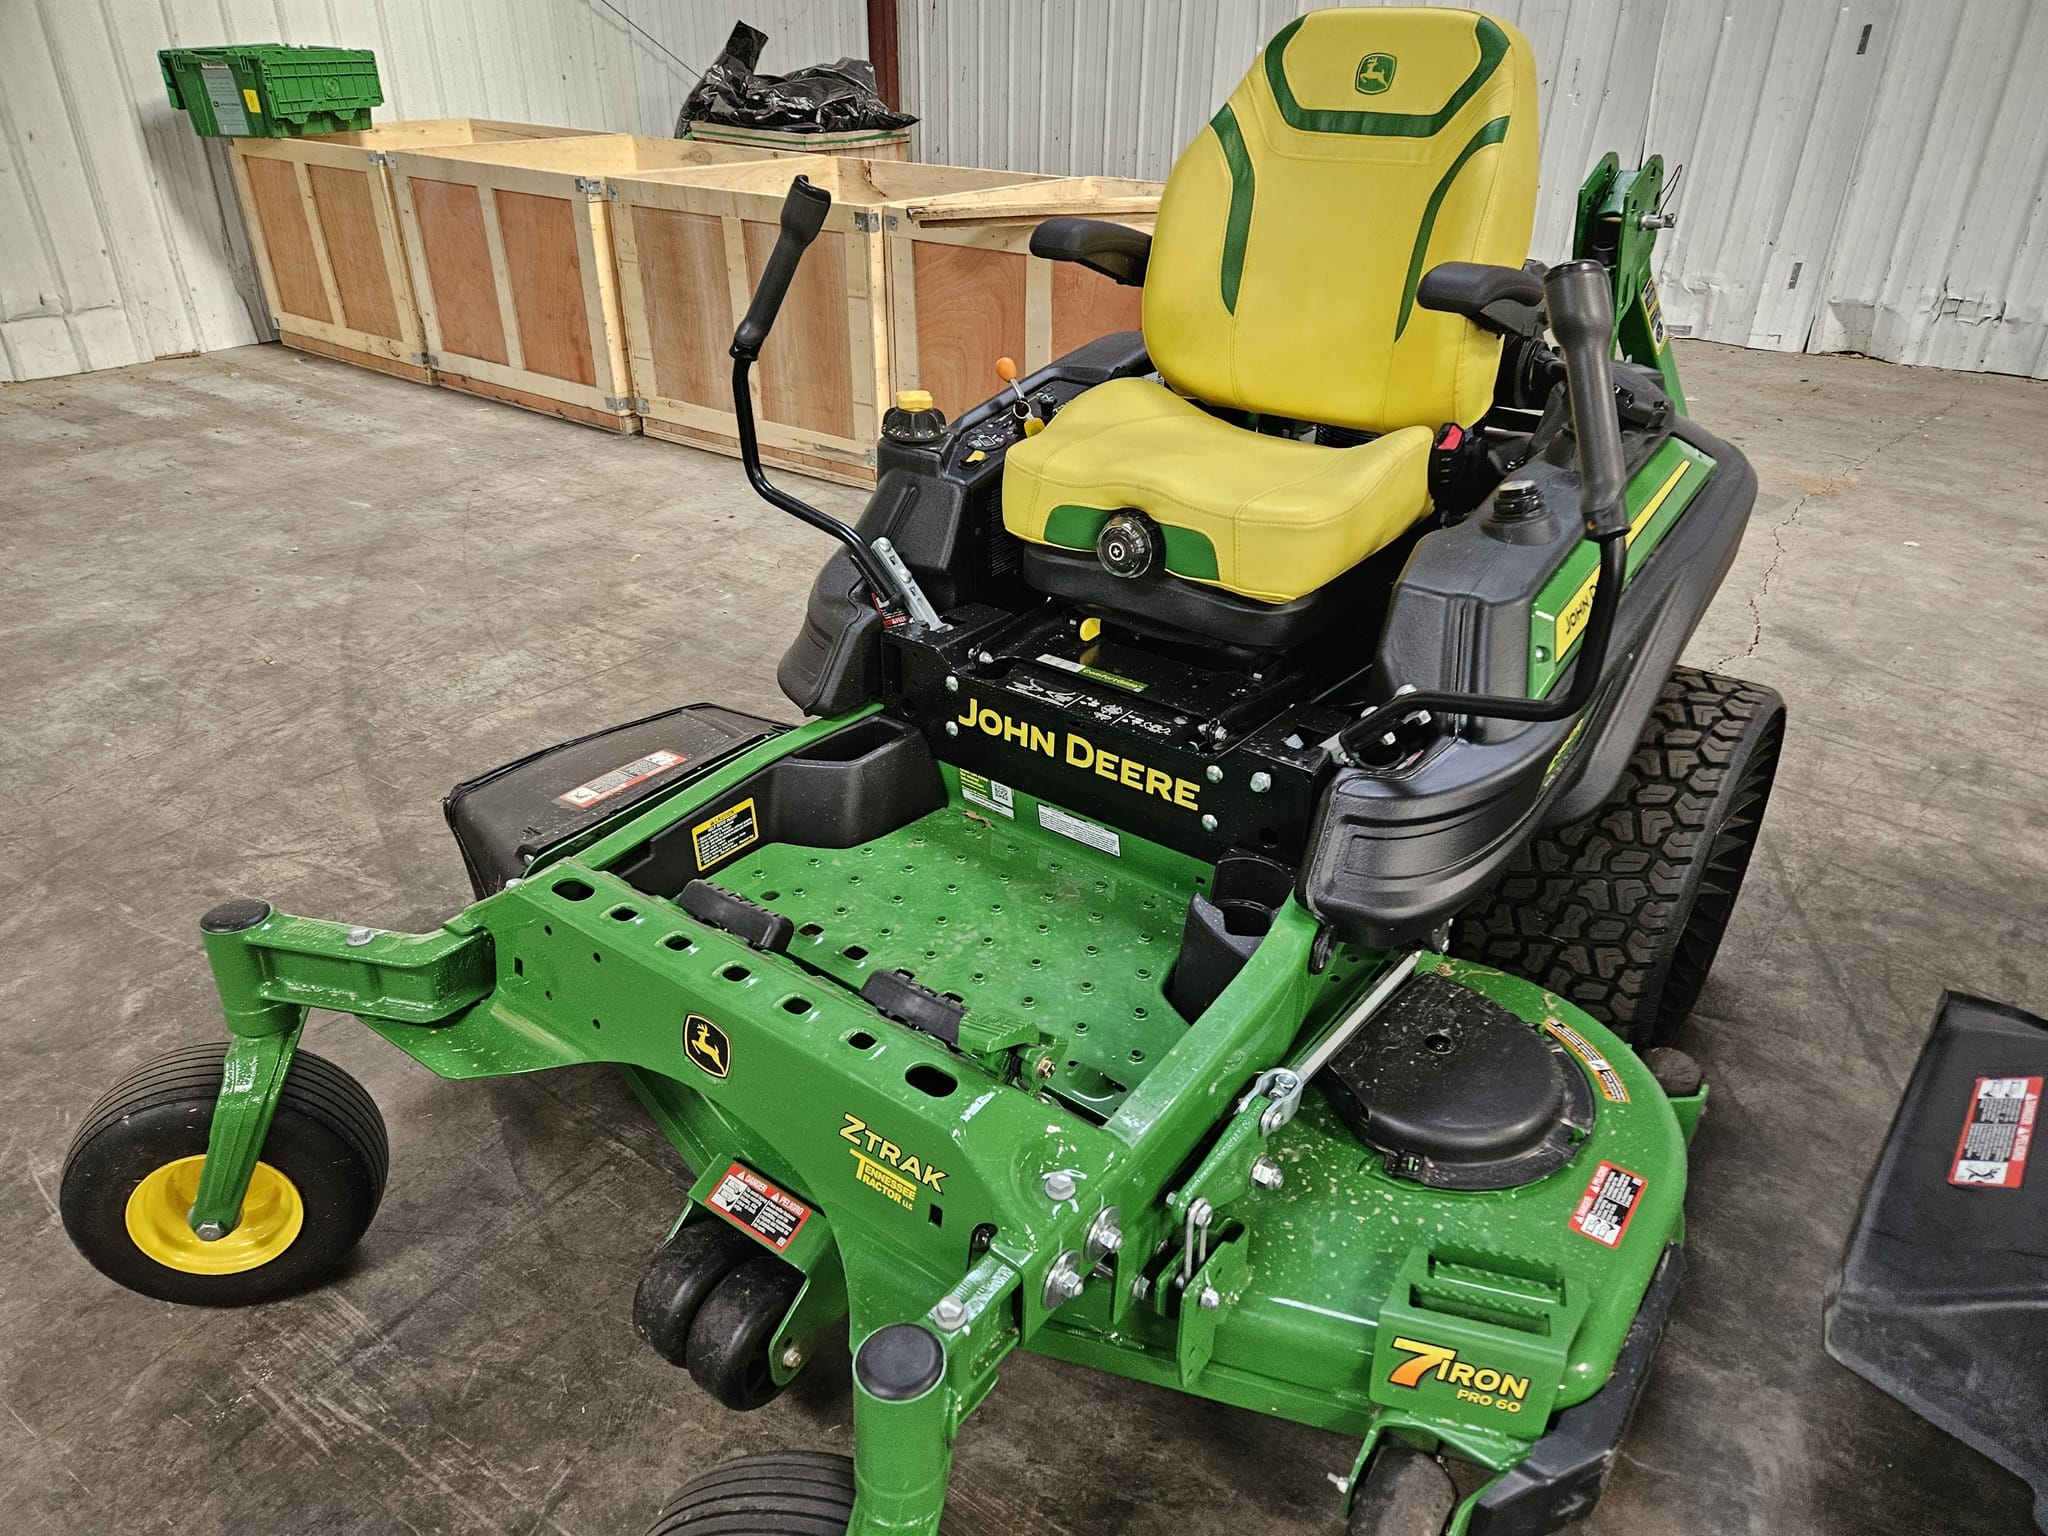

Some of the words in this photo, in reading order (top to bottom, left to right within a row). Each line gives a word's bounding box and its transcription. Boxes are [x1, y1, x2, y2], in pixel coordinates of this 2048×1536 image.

[1566, 596, 1591, 635] JOHN
[958, 697, 1055, 758] JOHN
[1065, 732, 1200, 811] DEERE
[840, 1112, 948, 1195] ZTRAK
[849, 1148, 917, 1201] TENNESSEE
[1456, 1388, 1493, 1406] PRO
[1495, 1399, 1521, 1413] 60
